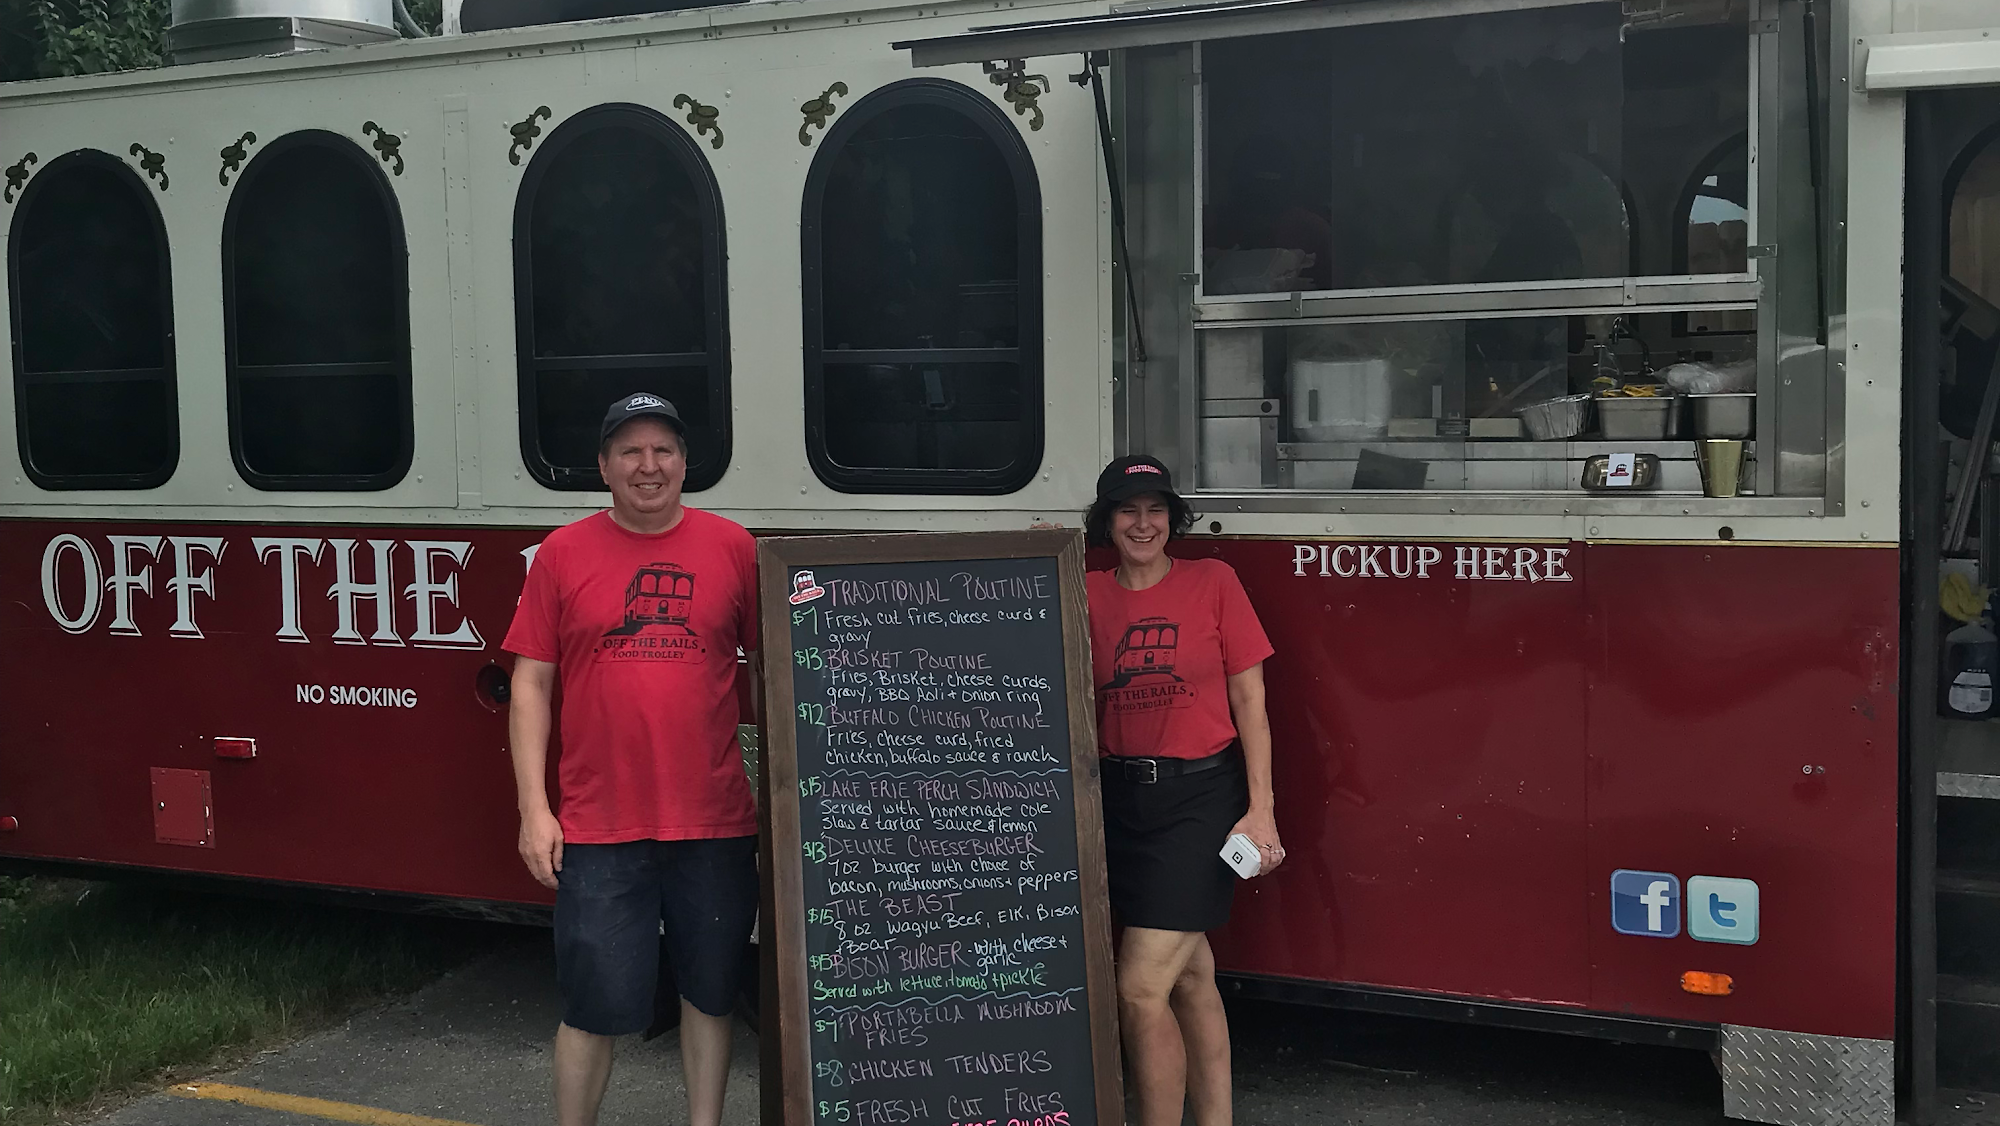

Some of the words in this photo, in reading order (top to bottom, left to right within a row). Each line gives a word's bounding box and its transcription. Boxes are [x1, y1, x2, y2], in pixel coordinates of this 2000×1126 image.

[1292, 544, 1442, 579] PICKUP
[1453, 546, 1573, 584] HERE
[40, 533, 229, 640] OFF
[251, 537, 487, 650] THE
[823, 578, 950, 606] TRADITIONAL
[950, 572, 1050, 600] POUTINE
[793, 606, 818, 635] $7
[824, 610, 872, 629] Fresh
[877, 610, 902, 625] cut
[997, 608, 1033, 621] curd
[603, 638, 627, 649] OFF
[631, 638, 657, 648] THE
[660, 637, 699, 650] RAILS
[828, 630, 872, 653] gravy
[612, 650, 639, 659] FOOD
[641, 650, 685, 659] TROLLEY
[794, 647, 823, 670] $13
[822, 649, 903, 670] BRISKET
[909, 648, 992, 670] POUTINE
[947, 671, 994, 687] cheese
[296, 683, 325, 704] NO
[329, 685, 418, 708] SMOKING
[874, 687, 910, 702] BBQ
[962, 689, 1001, 702] onion
[1006, 690, 1043, 716] ring
[1123, 689, 1149, 701] THE
[1150, 685, 1187, 697] RAILS
[798, 702, 826, 726] $12
[825, 705, 899, 726] BUFFALO
[908, 705, 971, 729] CHICKEN
[972, 706, 1050, 729] POUTINE
[877, 730, 925, 747] cheese
[974, 730, 1014, 748] fried
[889, 747, 941, 764] buffalo
[945, 751, 987, 764] sauce
[1006, 745, 1060, 764] ranch
[799, 776, 822, 798] $15
[821, 779, 861, 798] LAKE
[870, 779, 911, 799] ERIE
[913, 779, 960, 801] PERCH
[965, 777, 1060, 800] SANDWICH
[820, 799, 873, 816] Served
[883, 799, 920, 815] with
[927, 801, 1012, 818] homemade
[1020, 802, 1052, 817] cole
[875, 814, 924, 831] tartar
[802, 841, 827, 864] $13
[824, 835, 896, 858] DELUXE
[871, 857, 921, 881] burger
[931, 858, 963, 874] with
[1020, 852, 1037, 871] of
[1018, 870, 1079, 895] peppers
[807, 907, 835, 926] $15
[825, 899, 871, 919] THE
[878, 892, 962, 917] BEAST
[1036, 903, 1080, 921] Bison
[808, 953, 834, 972] $15
[829, 951, 890, 980] BISON
[892, 940, 971, 972] BURGER
[813, 979, 857, 1001] Served
[862, 978, 893, 997] with
[814, 1019, 838, 1043] $7
[841, 1004, 966, 1036] PORTABELLA
[977, 996, 1077, 1022] MUSHROOM
[865, 1025, 929, 1050] FRIES
[816, 1059, 843, 1087] $8
[849, 1058, 934, 1083] CHICKEN
[944, 1050, 1053, 1075] TENDERS
[855, 1098, 930, 1126] FRESH
[947, 1095, 983, 1119] CUT
[1004, 1087, 1065, 1114] FRIES
